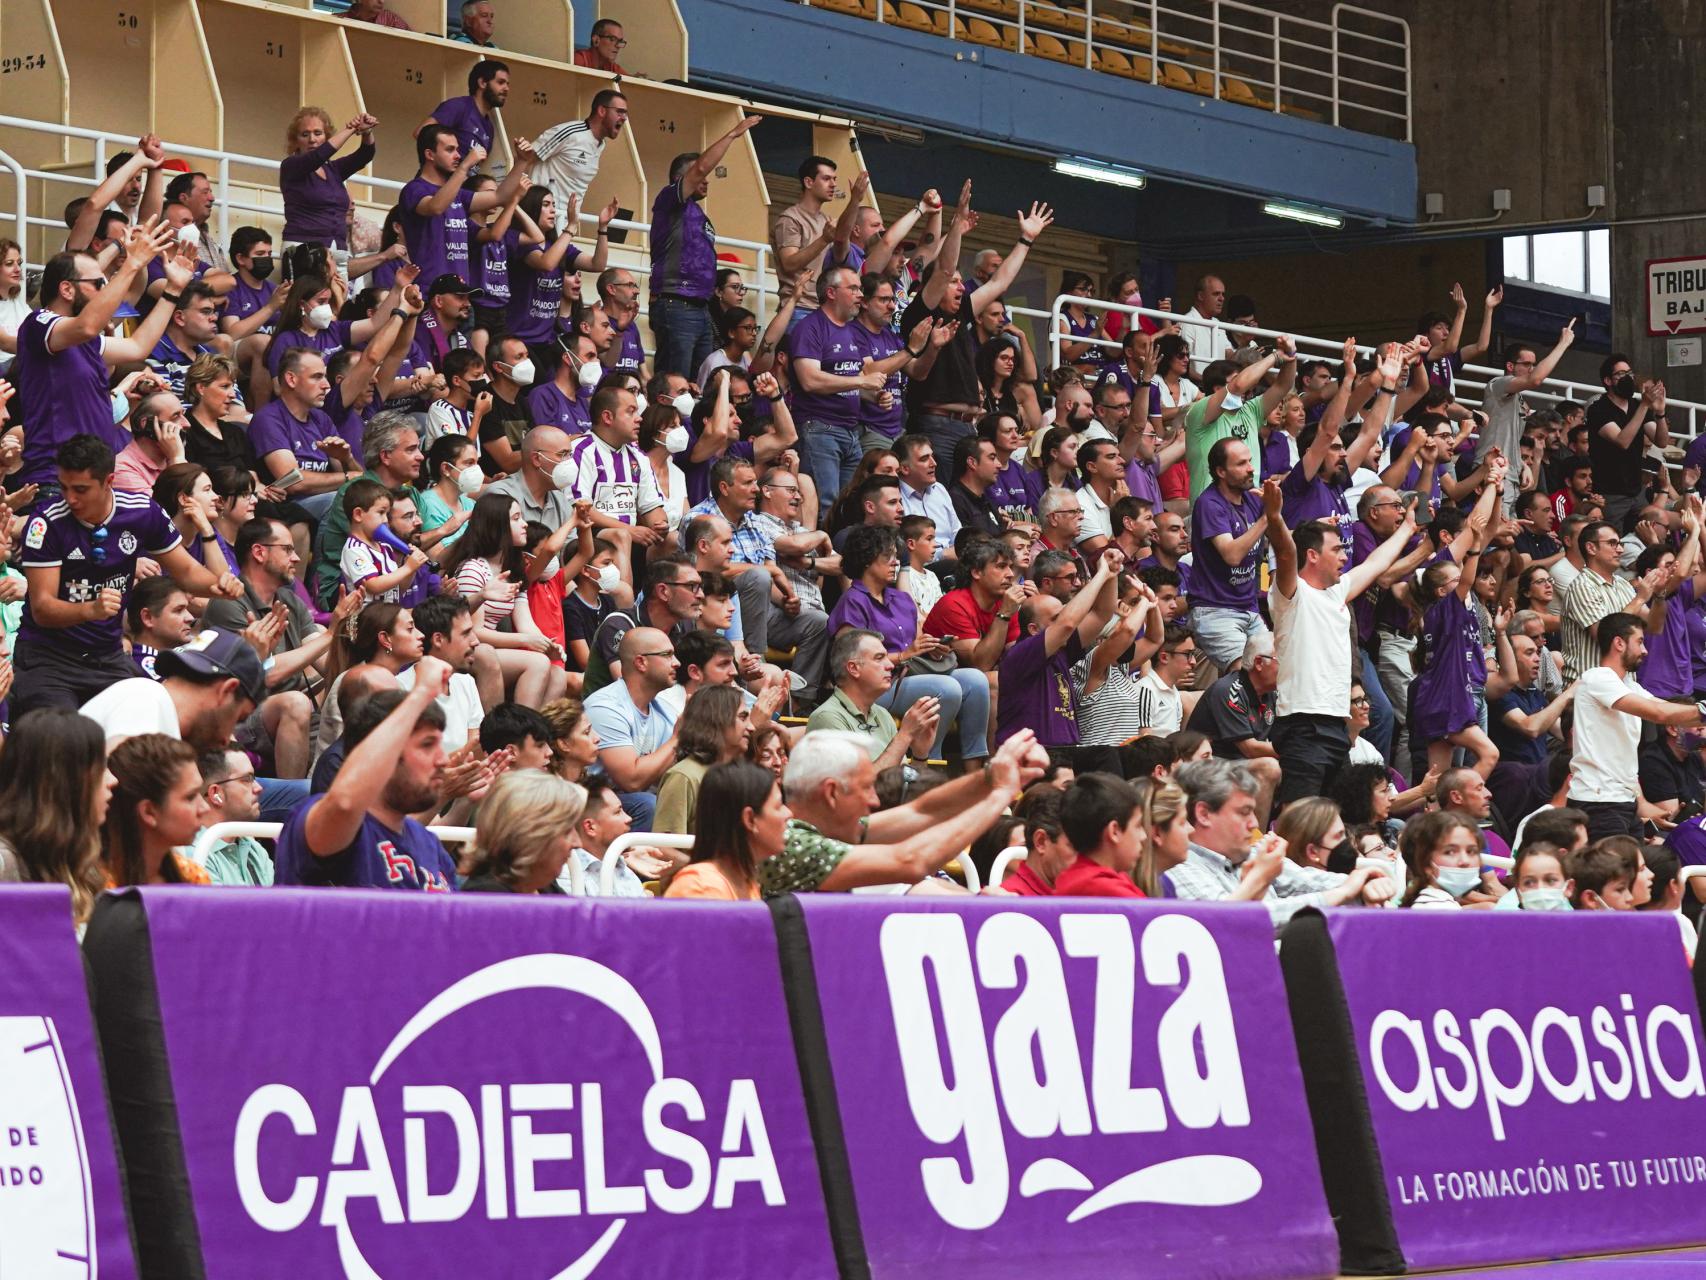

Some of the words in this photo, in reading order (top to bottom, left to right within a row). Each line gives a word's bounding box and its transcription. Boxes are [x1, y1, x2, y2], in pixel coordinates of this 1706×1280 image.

[1652, 268, 1706, 295] TRIBU
[1666, 299, 1704, 315] BAJ
[880, 912, 1252, 1230] gaza
[1369, 993, 1706, 1141] aspasia
[9, 1126, 39, 1147] DE
[234, 1077, 787, 1233] CADIELSA
[1397, 1175, 1429, 1204] LA
[1433, 1158, 1569, 1201] FORMACIÓN
[1574, 1162, 1605, 1191] DE
[1608, 1160, 1638, 1187] TU
